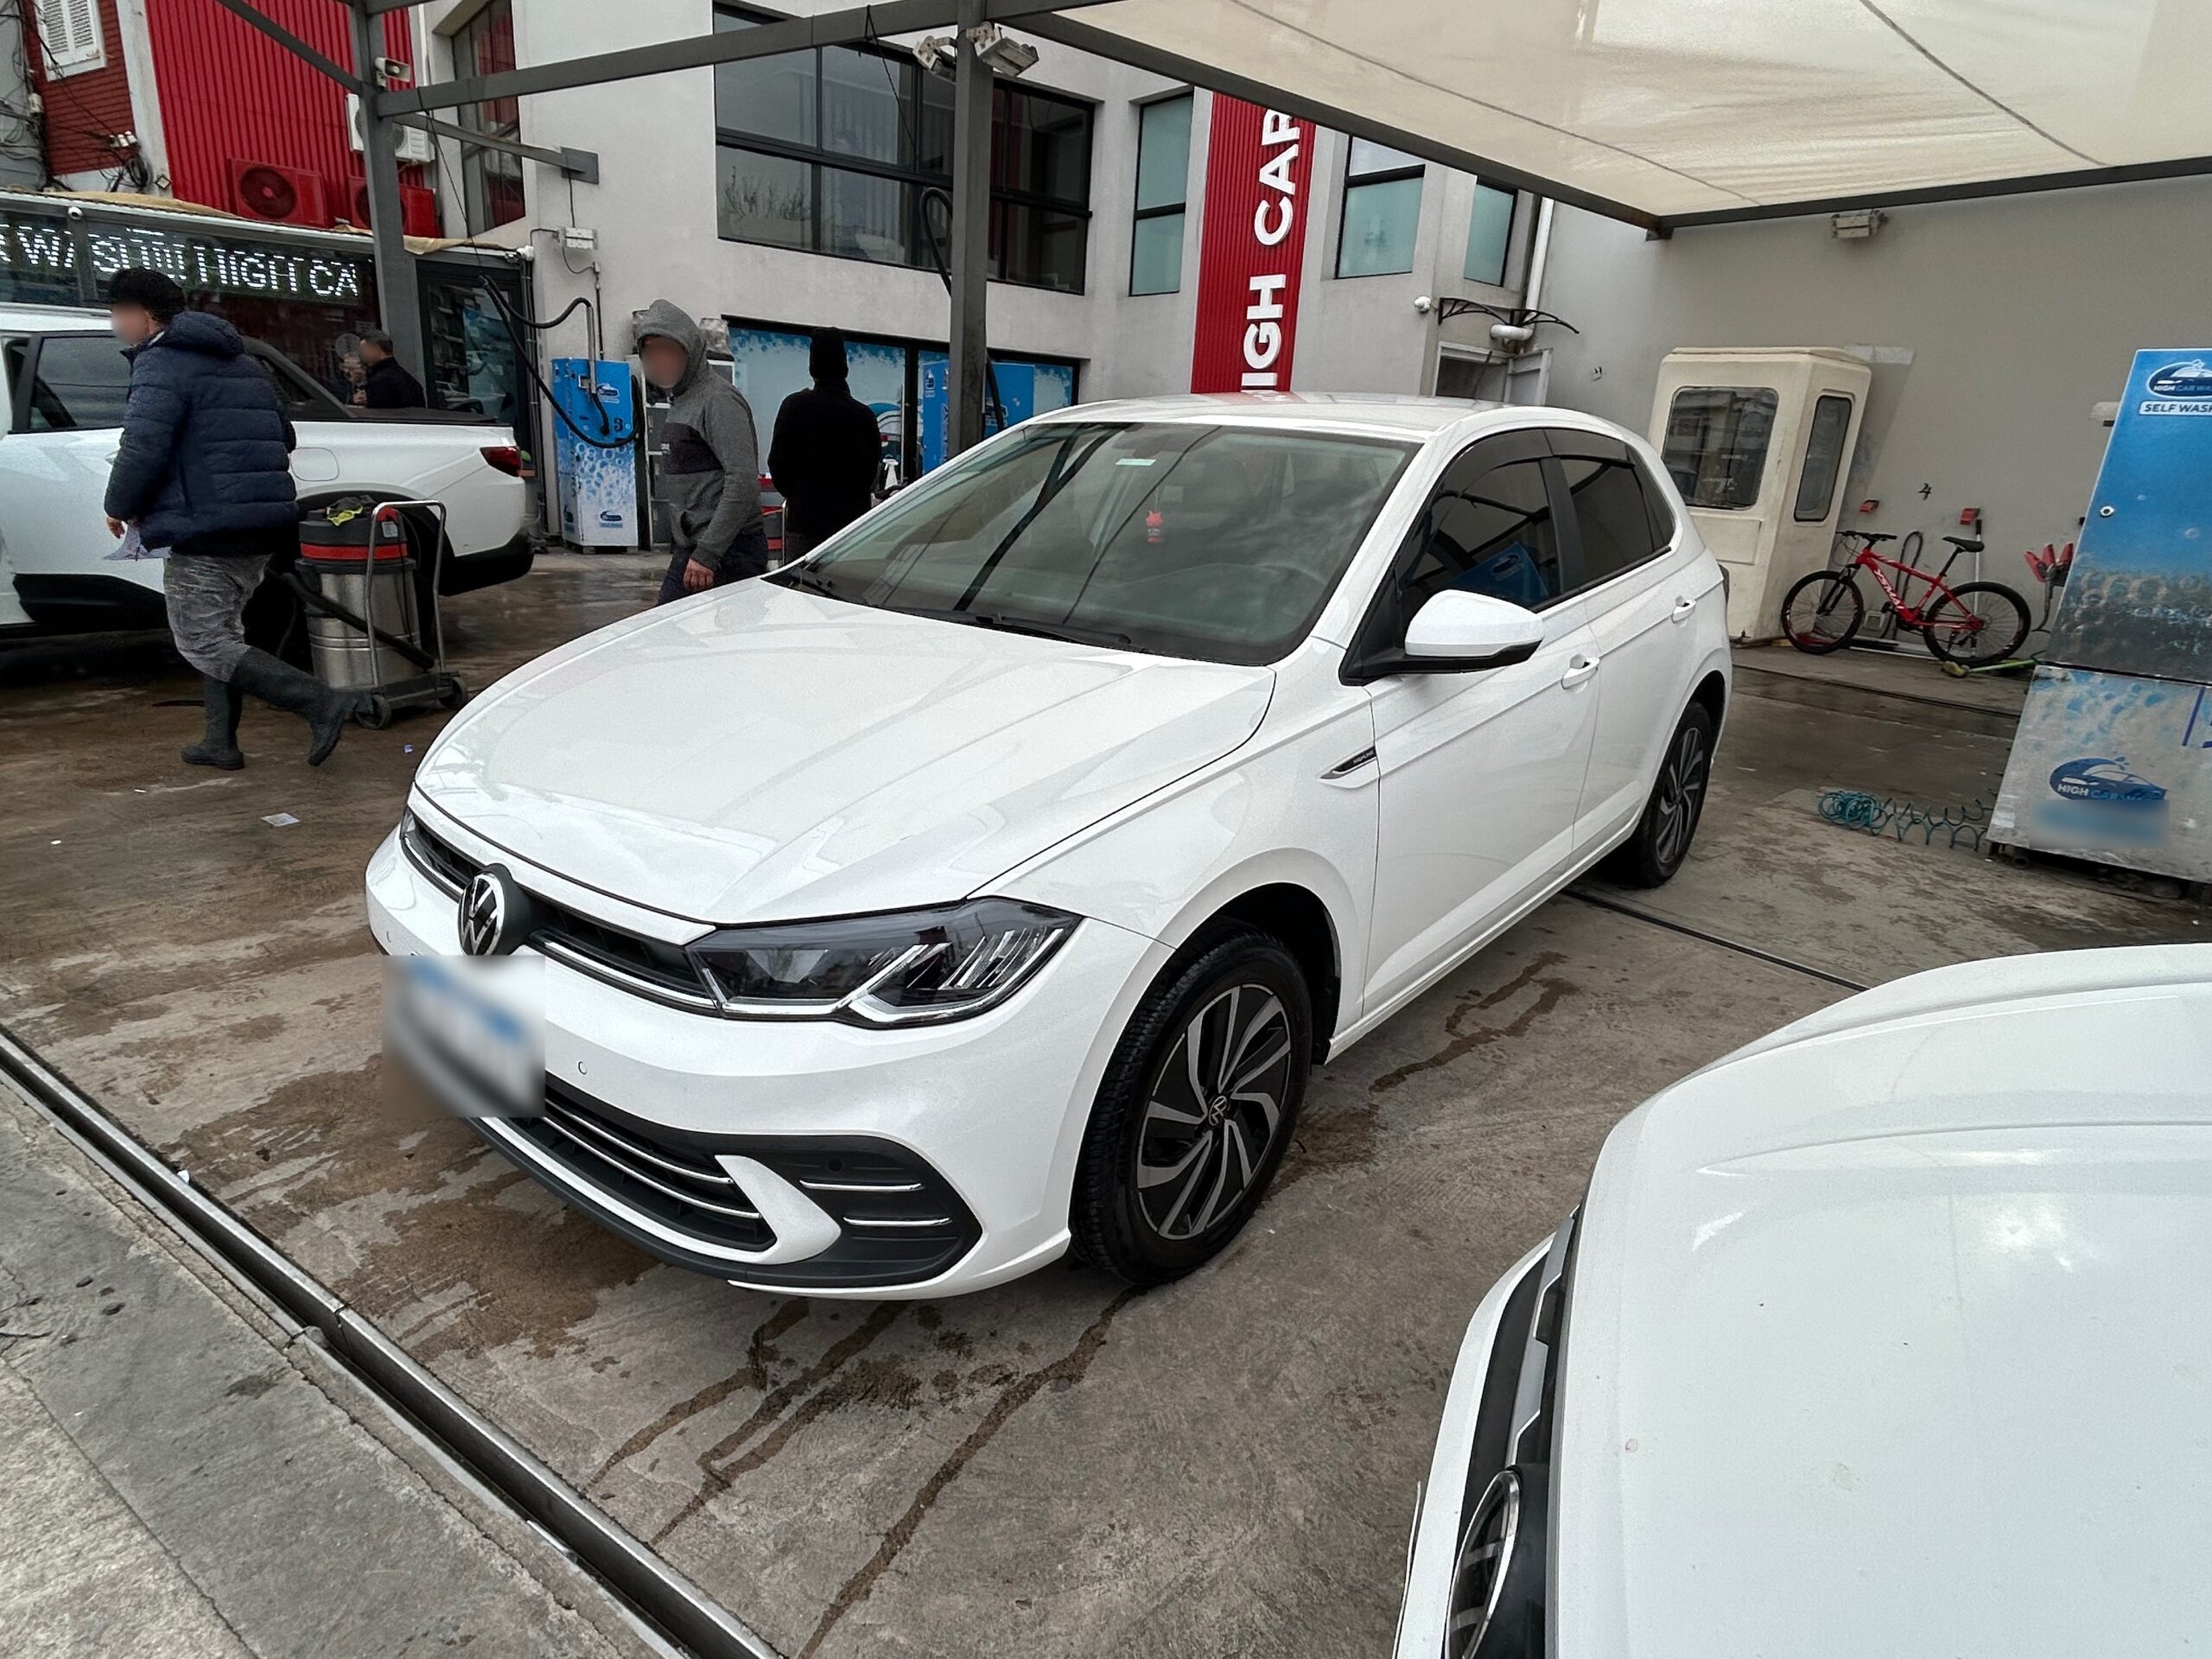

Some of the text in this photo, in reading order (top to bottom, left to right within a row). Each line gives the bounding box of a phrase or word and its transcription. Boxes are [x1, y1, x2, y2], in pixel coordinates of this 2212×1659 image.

[194, 245, 304, 291] HIGH
[1242, 274, 1286, 392] IGH
[2144, 404, 2177, 412] SELF
[1918, 482, 1932, 500] 4
[2057, 784, 2088, 797] HIGH
